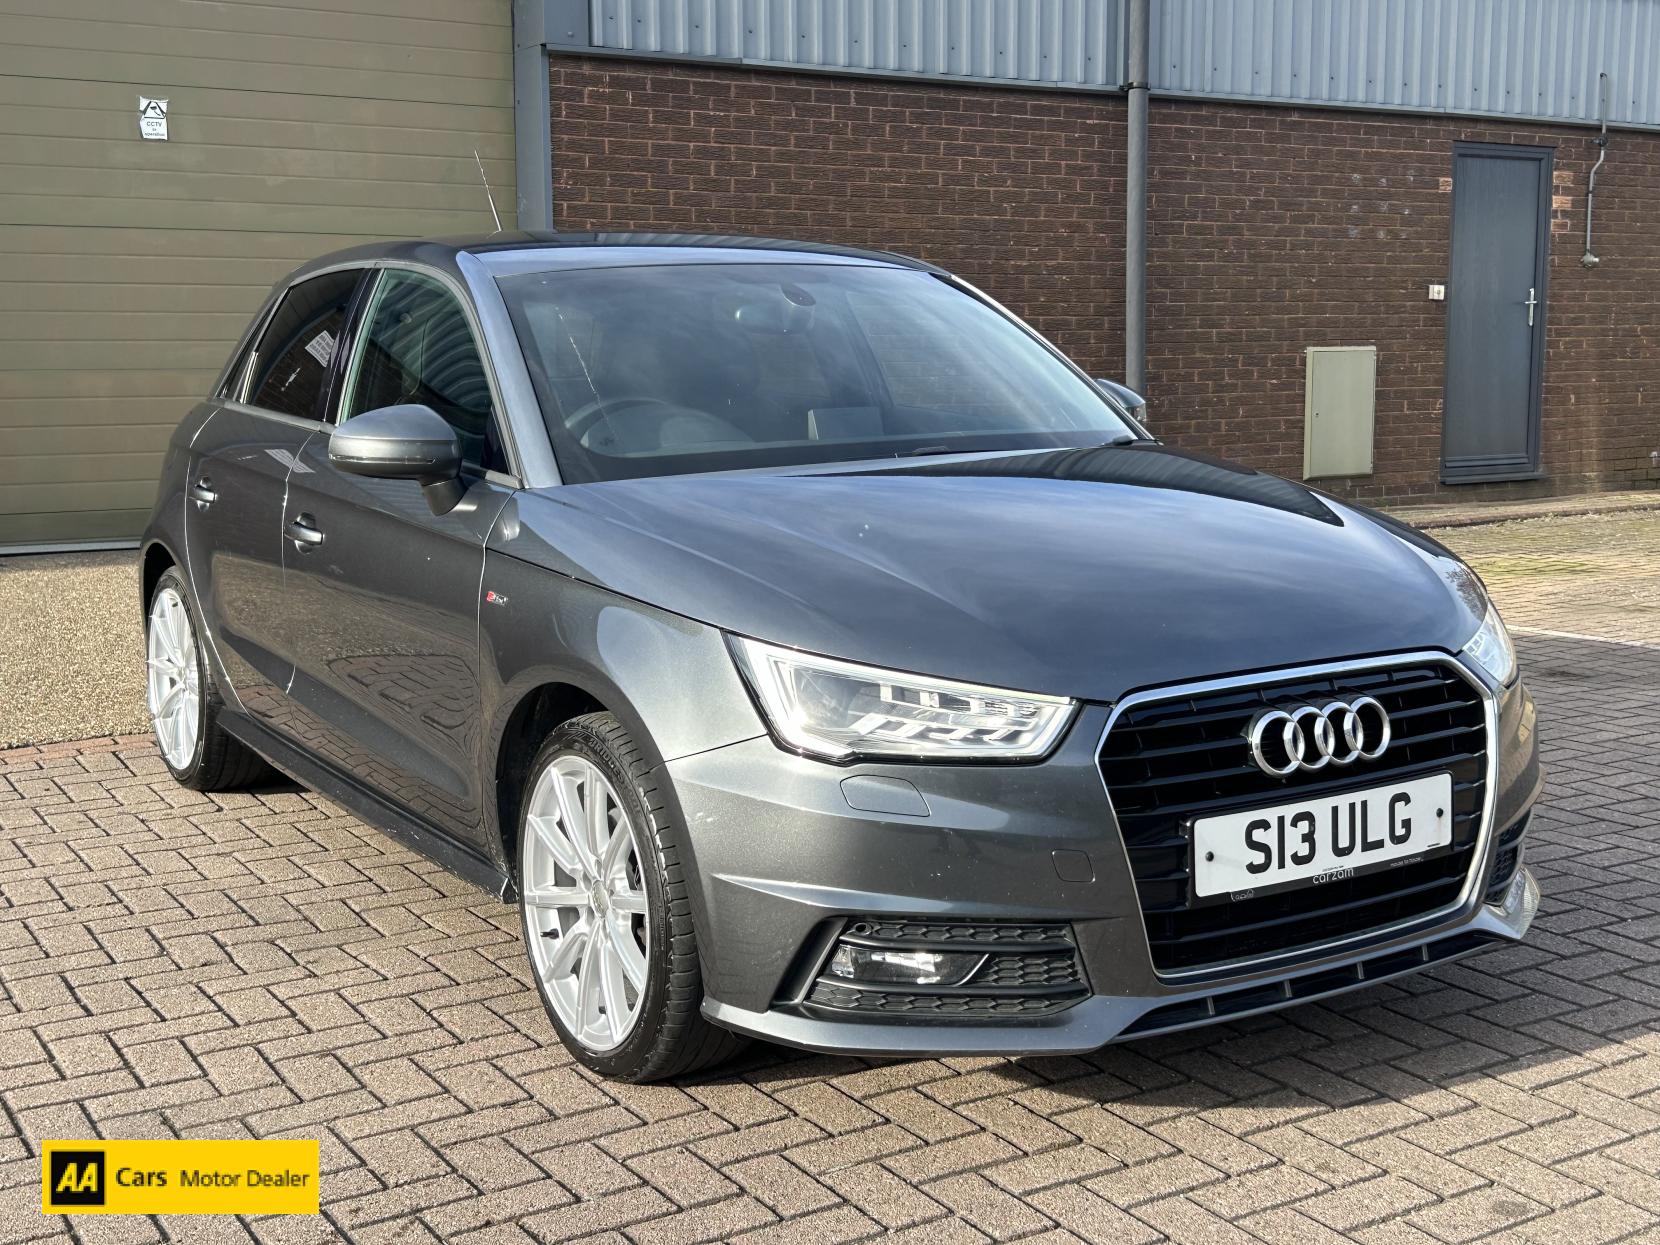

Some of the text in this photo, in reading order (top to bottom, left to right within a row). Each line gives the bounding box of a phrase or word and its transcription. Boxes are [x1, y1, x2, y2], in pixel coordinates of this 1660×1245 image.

[1245, 792, 1412, 874] S13 ULG
[1312, 867, 1354, 884] carzam
